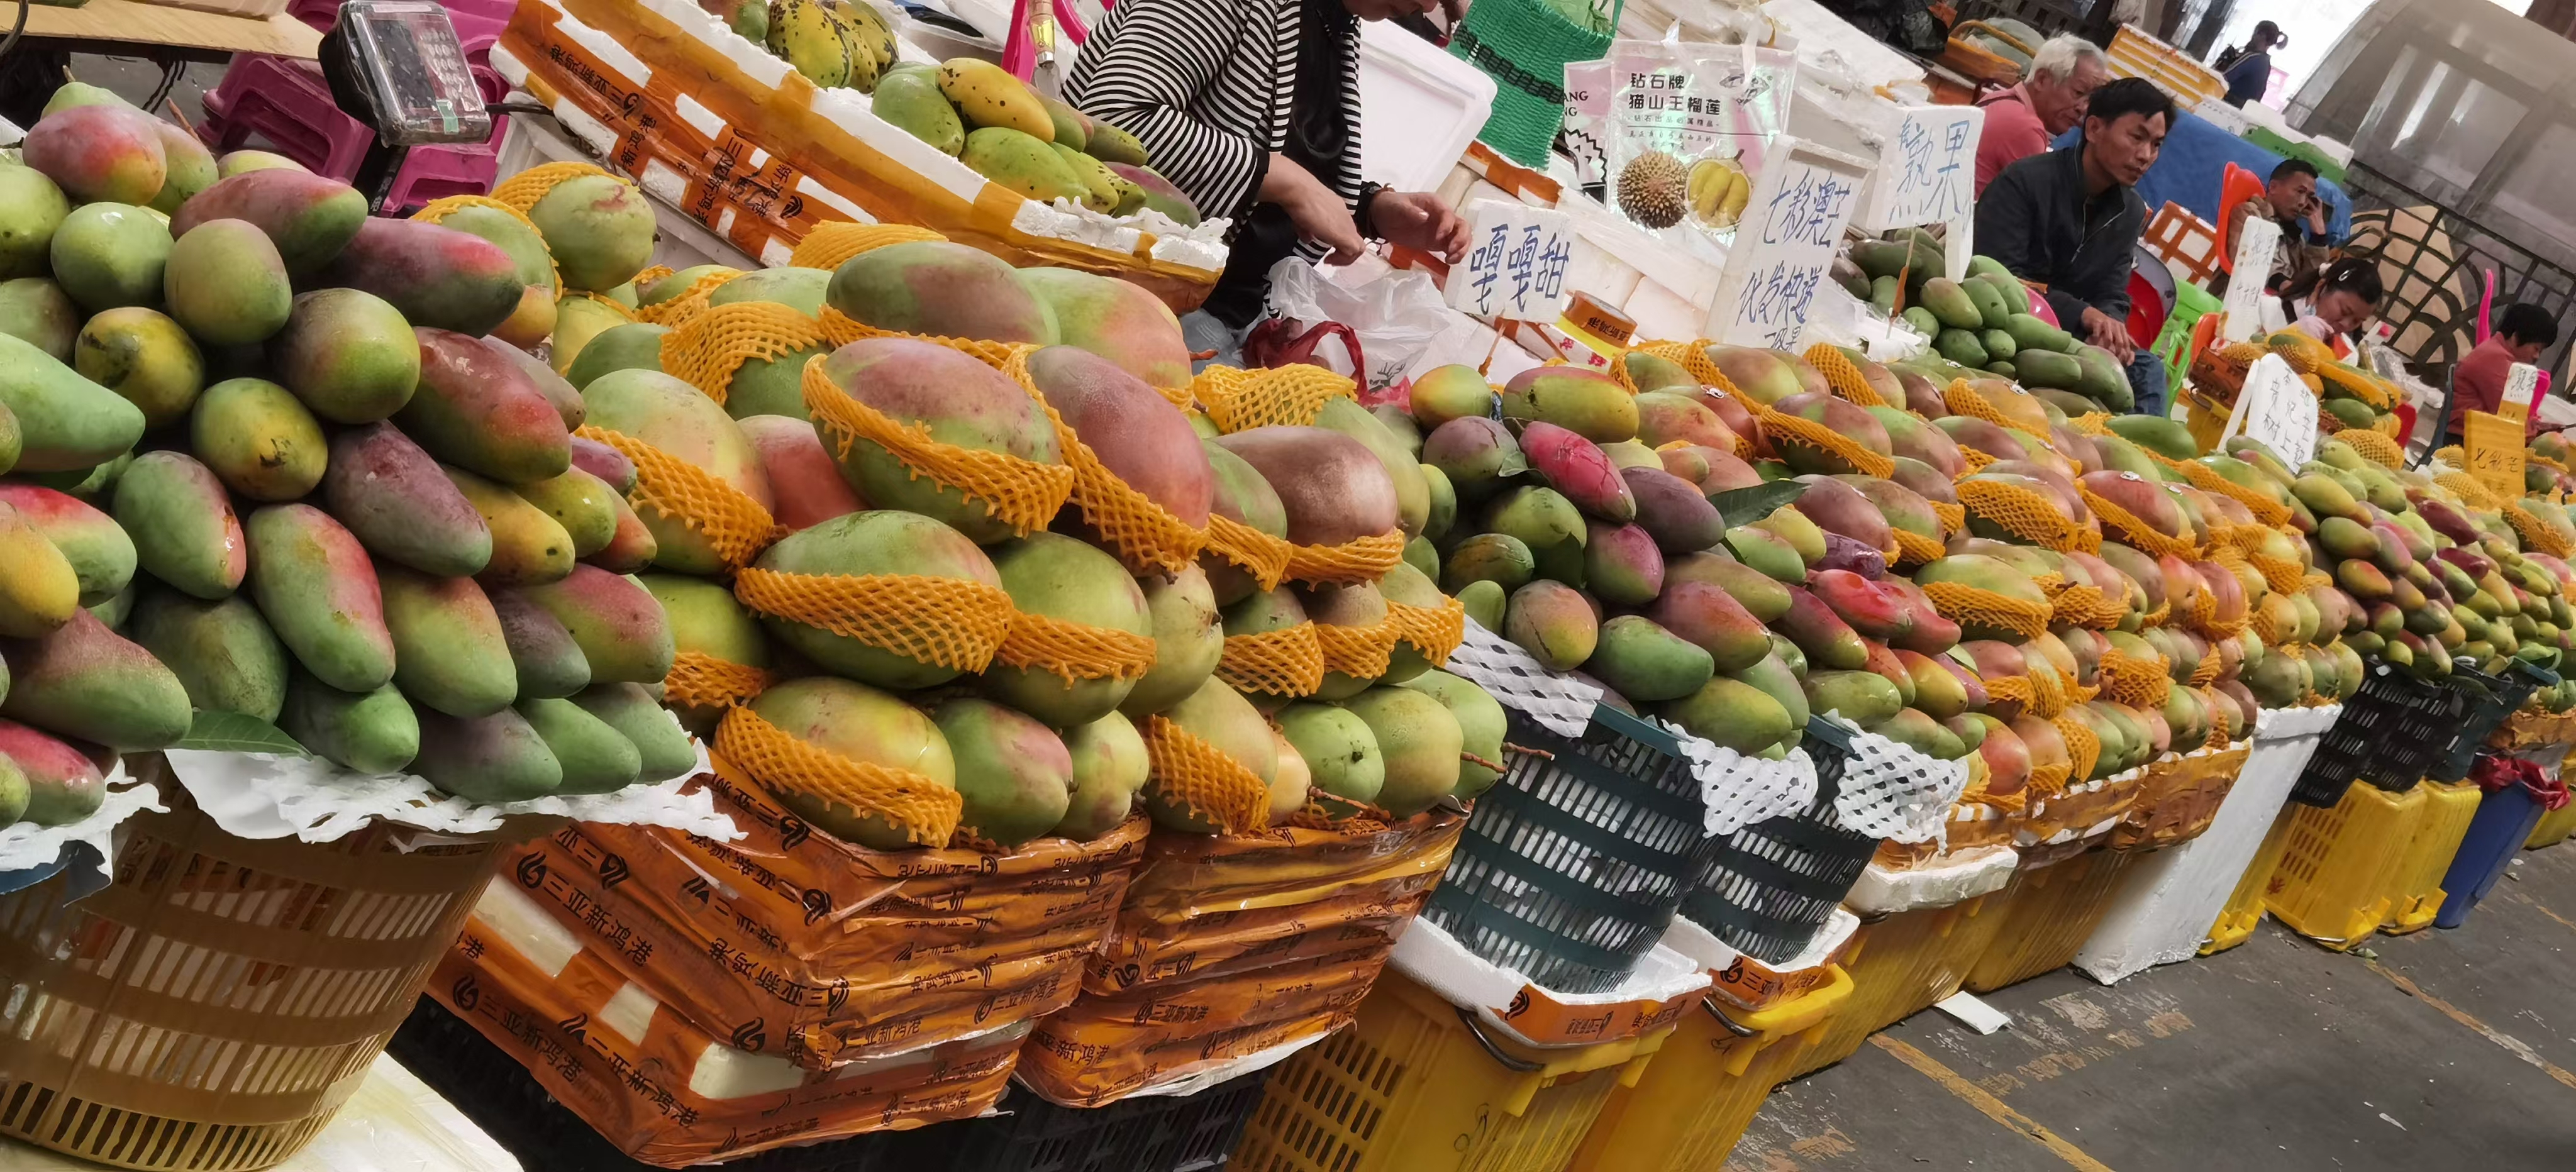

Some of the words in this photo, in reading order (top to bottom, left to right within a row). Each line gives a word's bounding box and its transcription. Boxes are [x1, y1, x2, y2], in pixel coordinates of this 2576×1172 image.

[1629, 94, 1720, 115] 猫山王榴莲
[1630, 73, 1685, 89] 钻石牌
[1889, 113, 1970, 224] 熟果
[1470, 223, 1570, 315] 嘎嘎甜
[2268, 379, 2311, 443] 贵妃芒
[2474, 447, 2521, 473] 七彩芒
[543, 871, 653, 967] 三亚新鸿港
[709, 937, 823, 1007] 三亚新鸿港
[479, 995, 584, 1083] 三亚新鸿港
